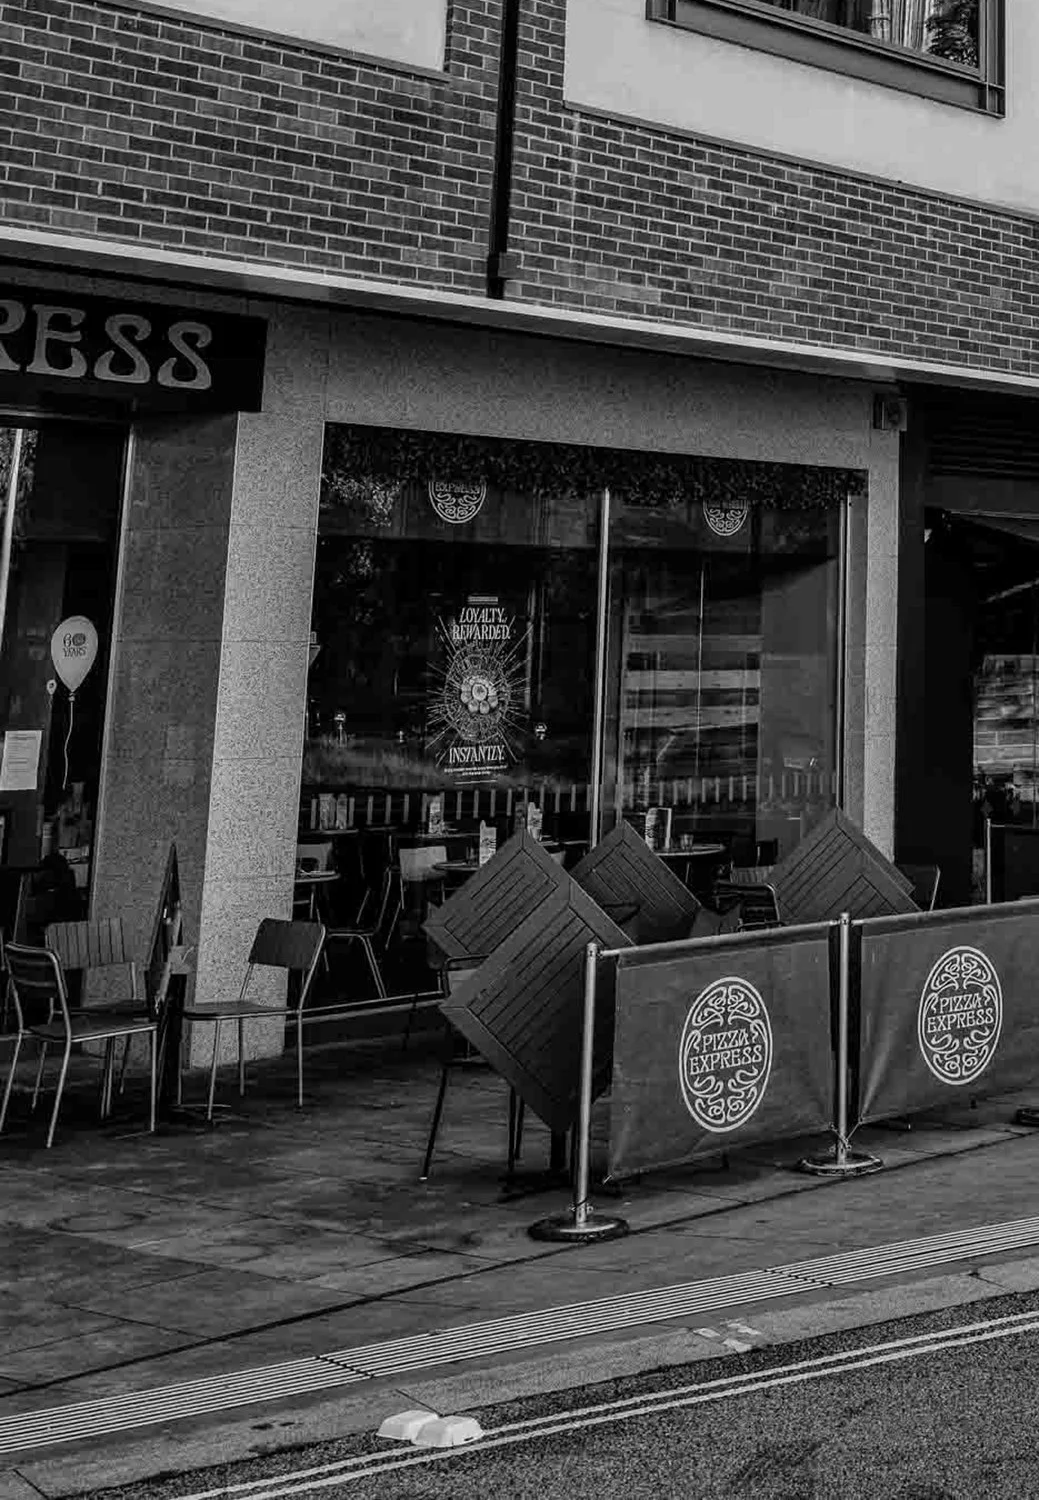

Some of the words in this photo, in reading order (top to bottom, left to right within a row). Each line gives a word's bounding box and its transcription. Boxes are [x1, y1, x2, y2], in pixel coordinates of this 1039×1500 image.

[452, 623, 511, 640] REWARDED.
[62, 646, 88, 658] YEARS
[939, 993, 982, 1014] PIZZA
[927, 1007, 994, 1033] EXPRESS
[702, 1028, 749, 1053] PIZZA
[689, 1044, 762, 1076] EXPRESS
